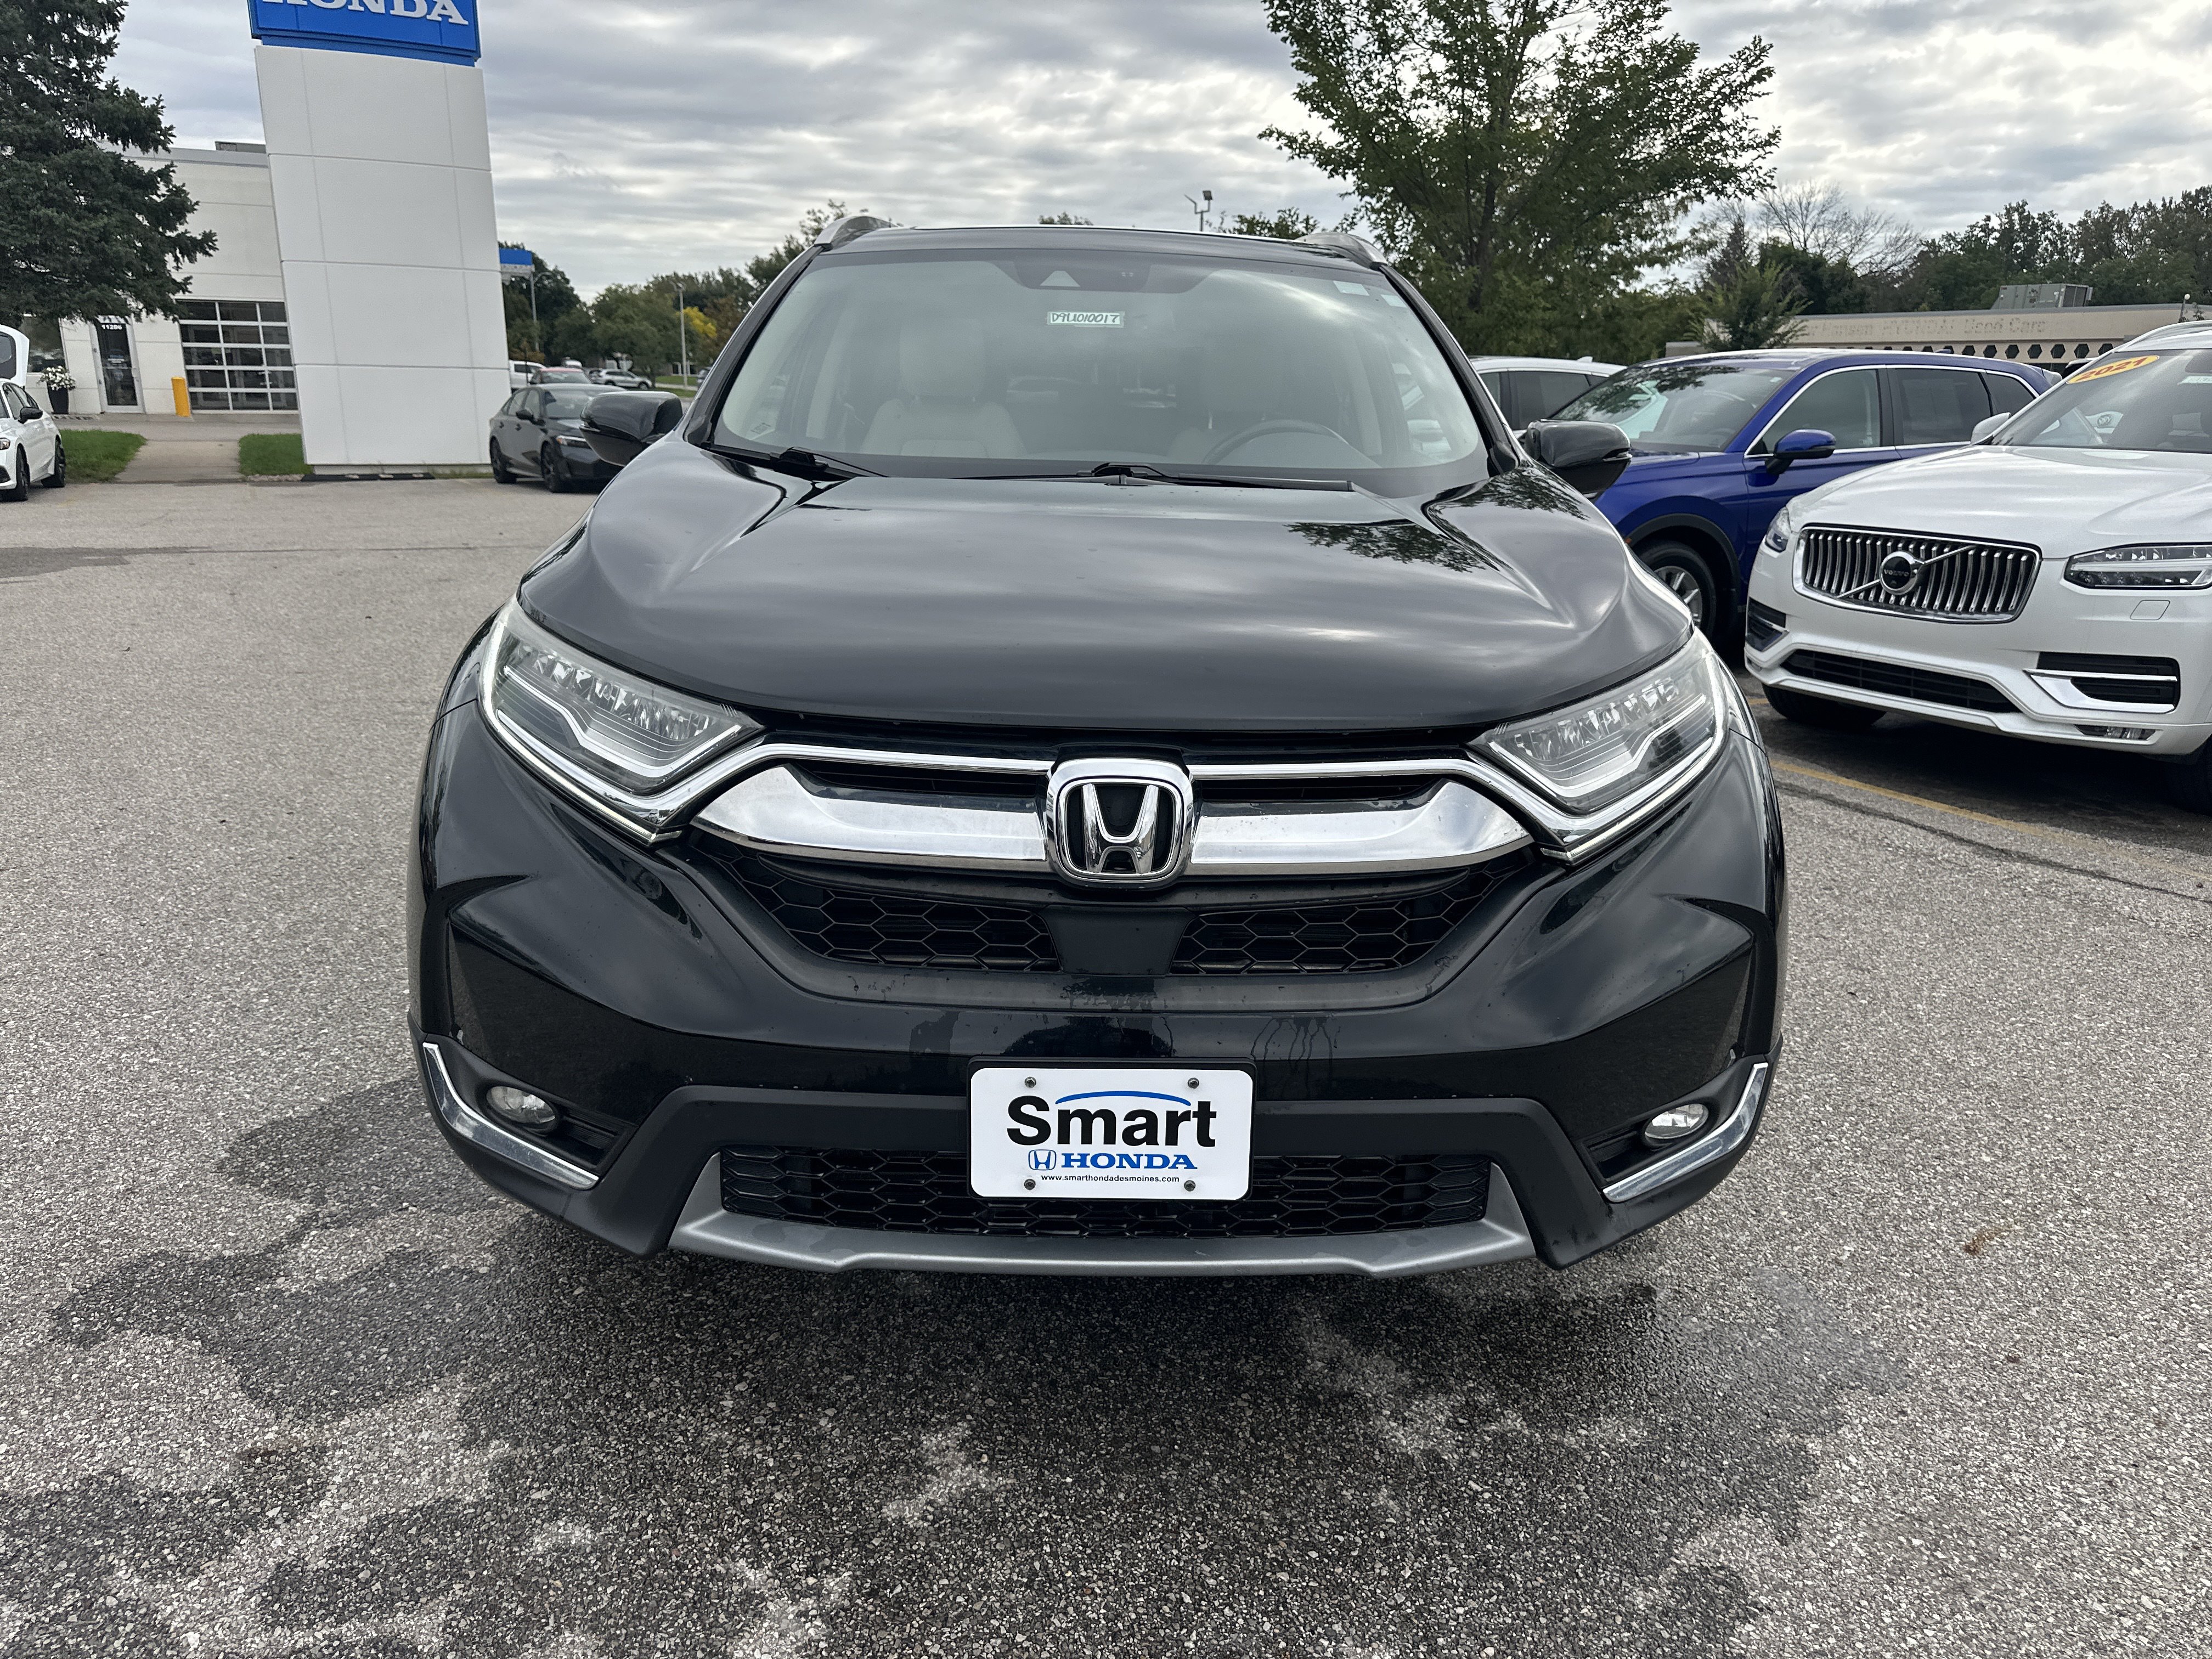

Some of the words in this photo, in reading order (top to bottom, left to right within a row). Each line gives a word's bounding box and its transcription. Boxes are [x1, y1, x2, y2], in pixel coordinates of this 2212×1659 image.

[2075, 357, 2147, 382] 2021
[1883, 569, 1910, 577] VOLVO
[1007, 1095, 1217, 1147] Smart
[1062, 1153, 1198, 1170] HONDA
[1041, 1175, 1180, 1183] www.smarthondadesmoines.com
